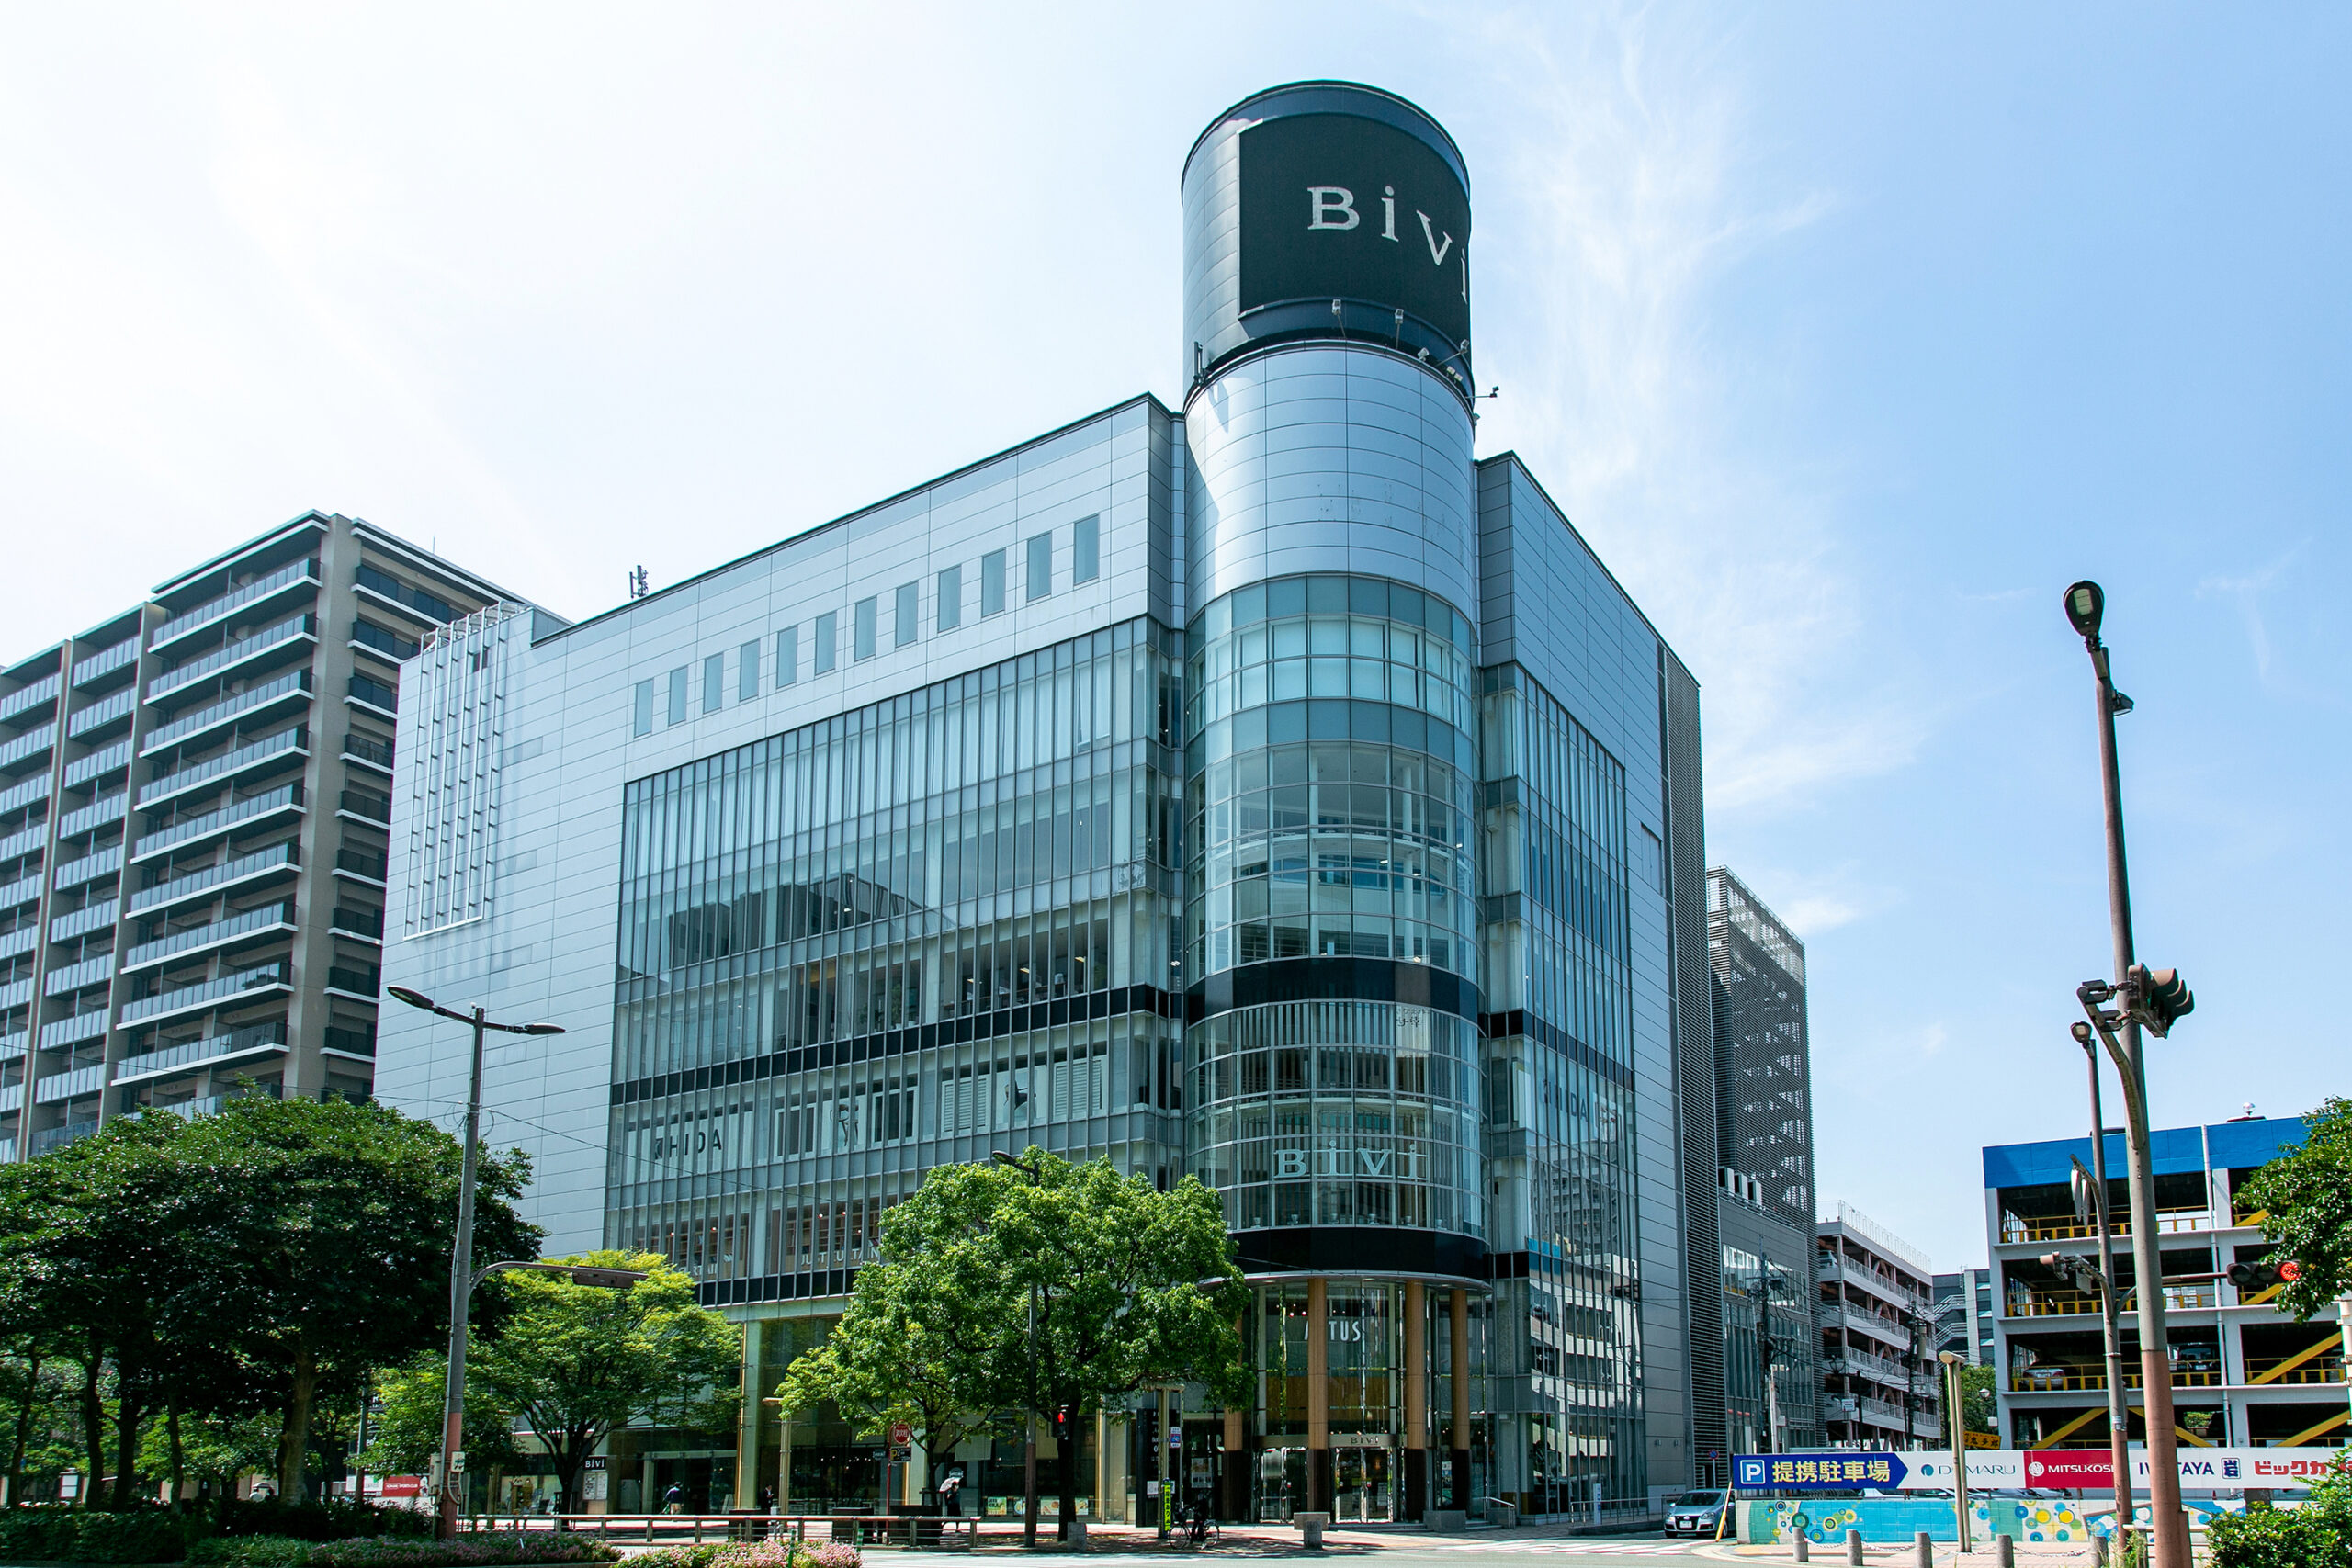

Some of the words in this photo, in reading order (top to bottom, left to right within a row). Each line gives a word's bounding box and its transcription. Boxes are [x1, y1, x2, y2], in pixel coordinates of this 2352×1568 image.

[801, 1252, 827, 1265] JUT
[1304, 1320, 1361, 1342] TUS
[1747, 1464, 1761, 1481] P
[1772, 1461, 1891, 1483] 提携駐車場
[1939, 1464, 2016, 1475] DMARU
[2048, 1464, 2114, 1473] MITSUKOS
[2139, 1461, 2215, 1475] IAYA
[2254, 1461, 2352, 1476] ビックカ
